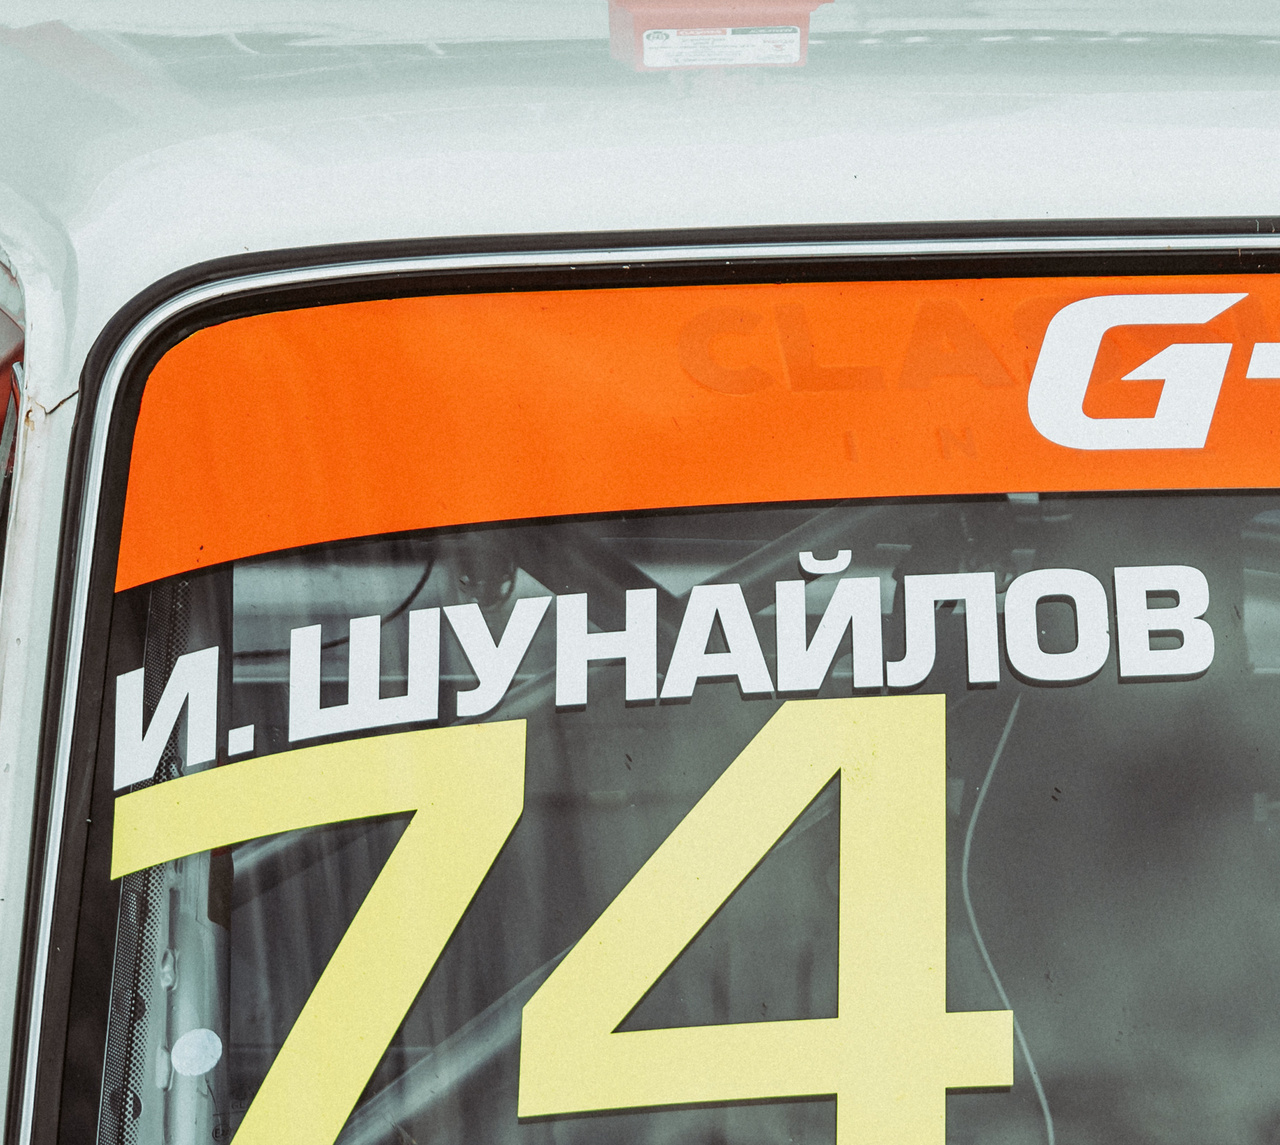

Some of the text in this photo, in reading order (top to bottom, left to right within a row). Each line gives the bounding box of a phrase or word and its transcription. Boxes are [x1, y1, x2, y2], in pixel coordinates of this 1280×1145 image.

[113, 548, 1216, 792] И. ШУНАЙЛОВ
[110, 696, 1014, 1145] 74
